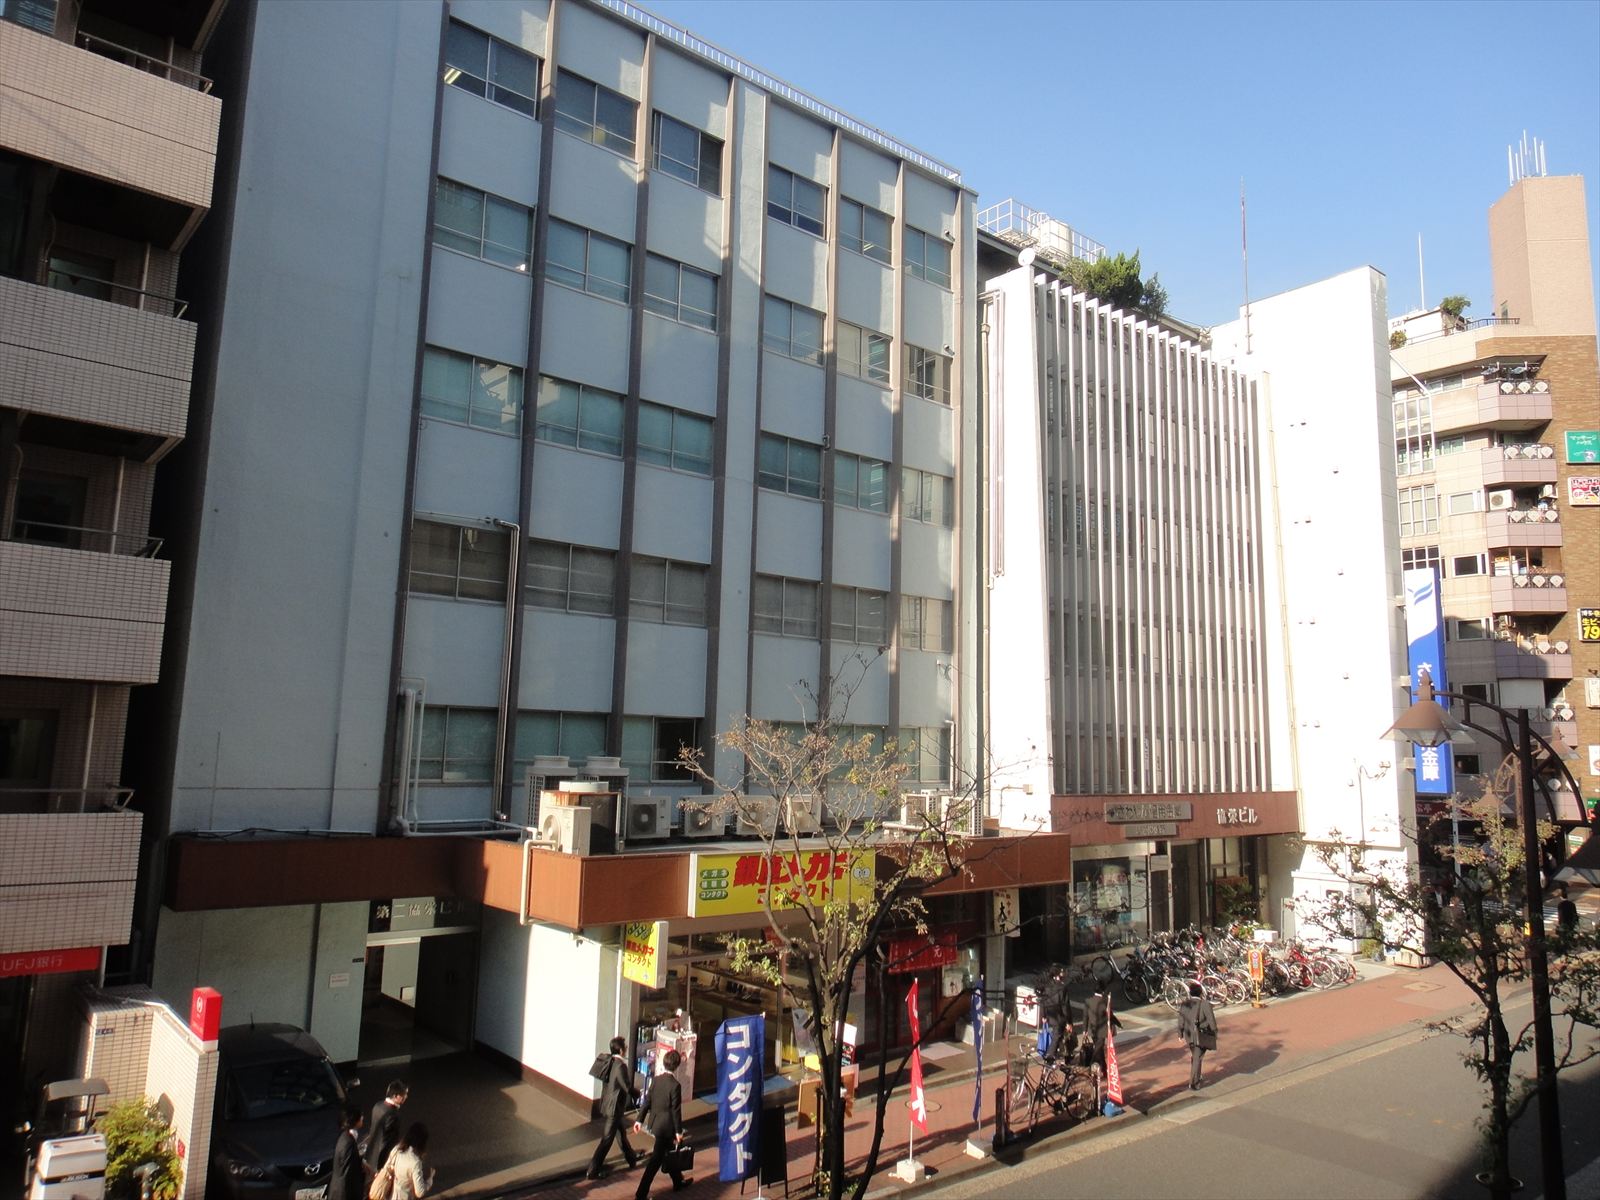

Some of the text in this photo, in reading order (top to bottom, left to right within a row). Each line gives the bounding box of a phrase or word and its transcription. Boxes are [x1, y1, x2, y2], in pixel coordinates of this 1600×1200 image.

[627, 953, 652, 968] コンタクト
[726, 1023, 753, 1175] コンタクト
